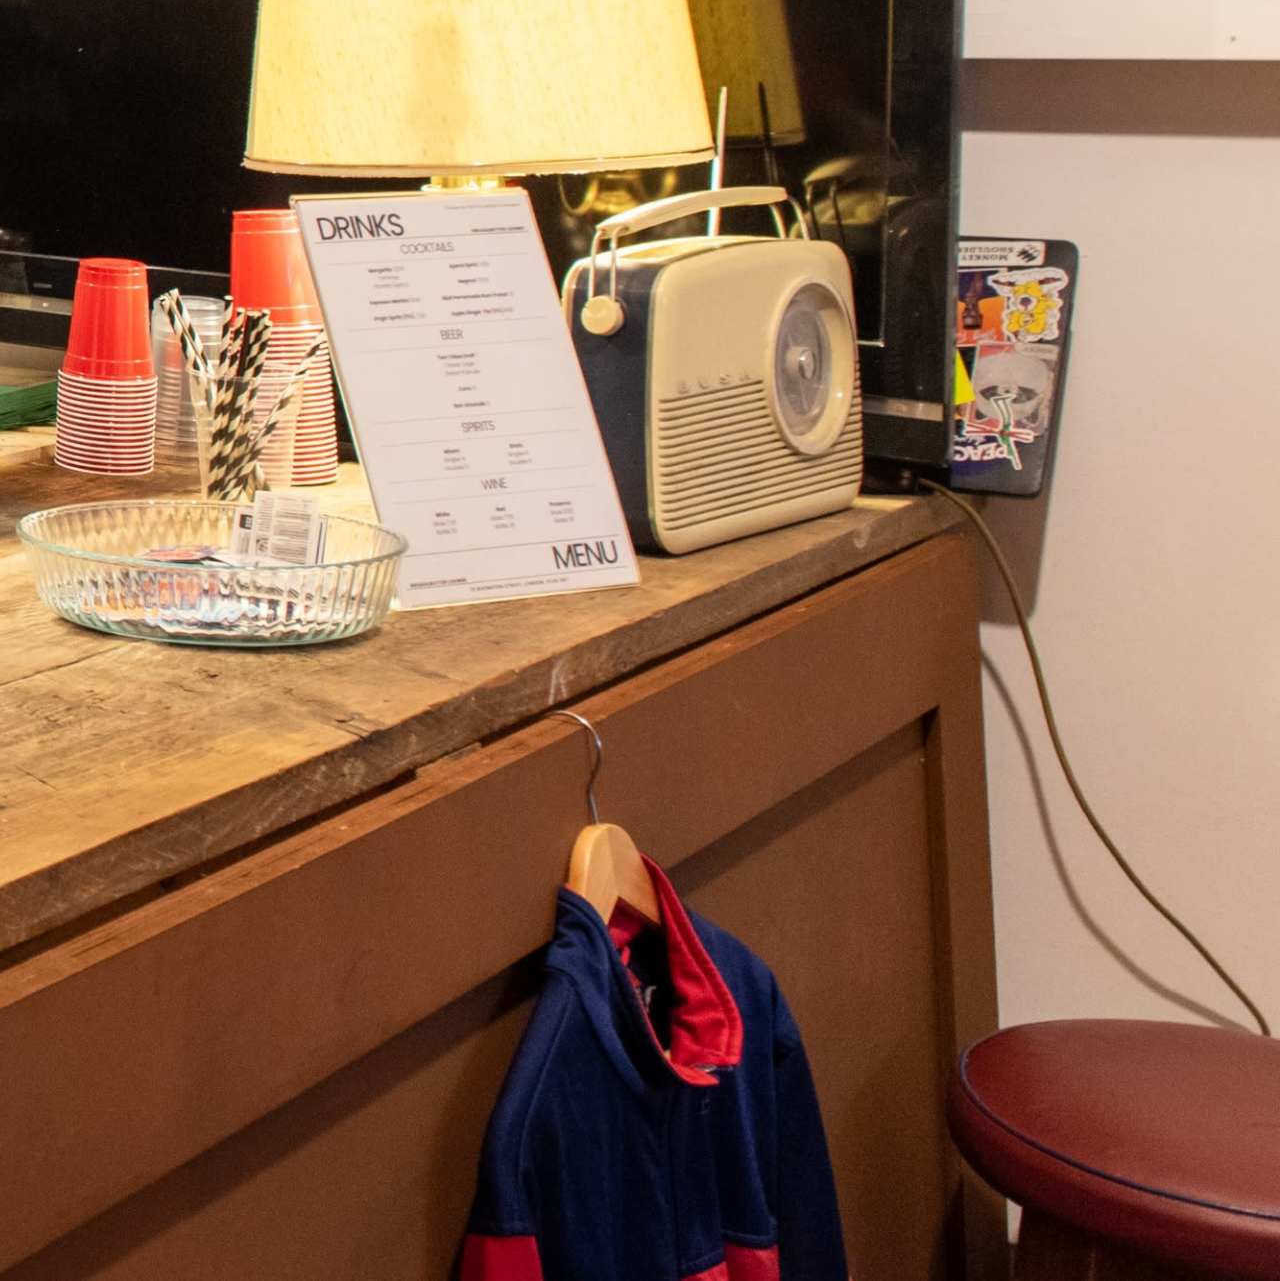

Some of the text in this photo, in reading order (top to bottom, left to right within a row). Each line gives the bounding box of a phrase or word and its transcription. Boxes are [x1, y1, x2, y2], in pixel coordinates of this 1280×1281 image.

[316, 213, 405, 241] DRINKS
[400, 241, 455, 255] COCKTAILS
[439, 328, 464, 340] BEER
[460, 420, 496, 433] SPIRITS
[480, 477, 508, 490] WINE
[551, 540, 619, 569] MENU
